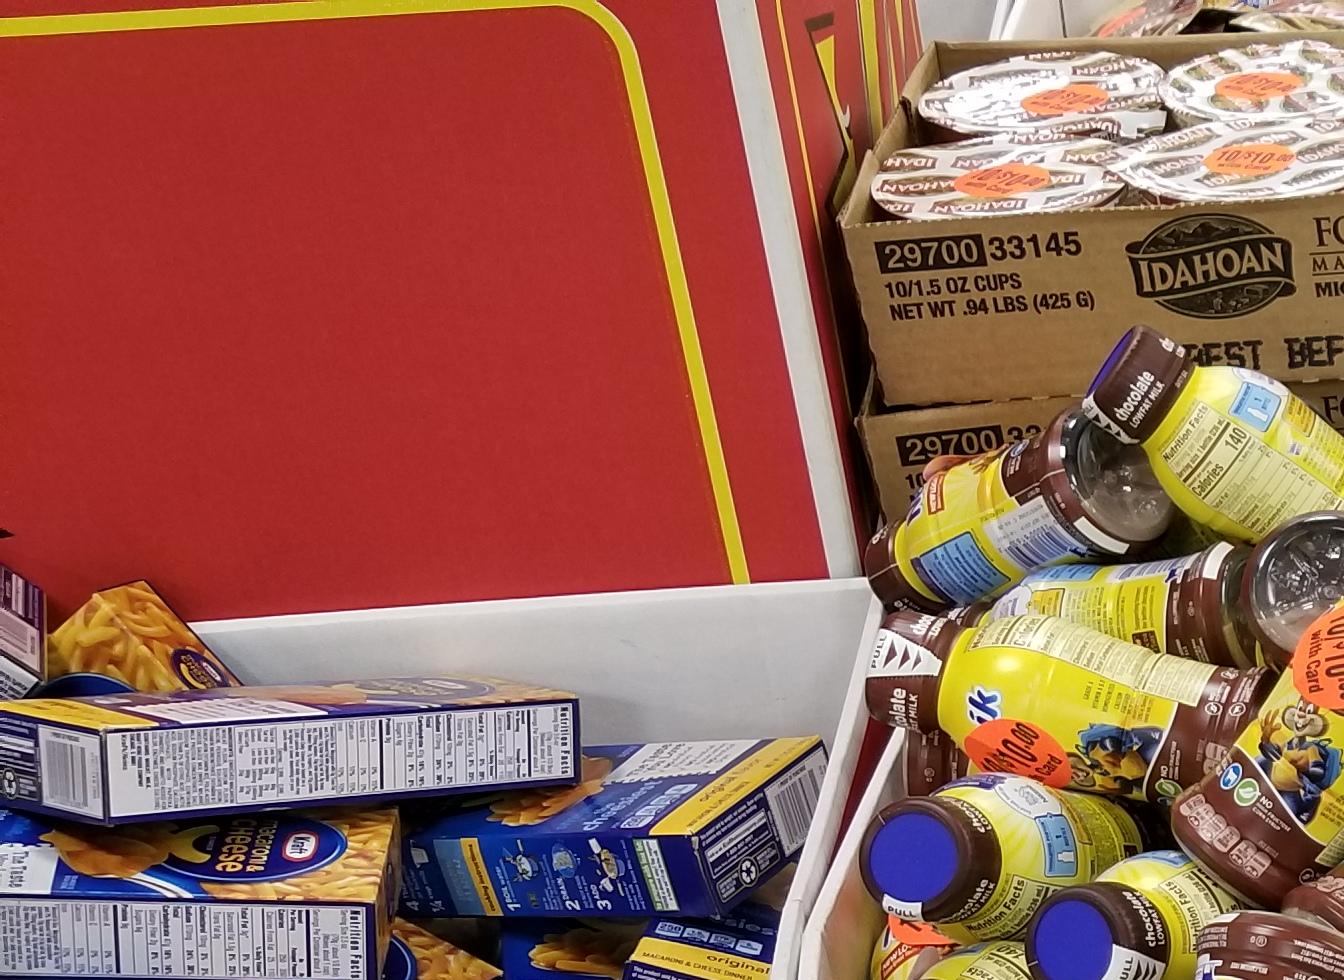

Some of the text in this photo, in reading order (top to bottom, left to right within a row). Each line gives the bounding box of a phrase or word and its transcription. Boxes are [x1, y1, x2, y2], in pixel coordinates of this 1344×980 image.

[884, 231, 1082, 269] 29700 33145
[1137, 242, 1286, 294] IDAHOAN
[885, 273, 1022, 298] 10/1.5 OZ CUPS
[890, 291, 1095, 321] NET WT .94 LBS (425 G)
[1113, 371, 1155, 421] chocolate
[905, 429, 997, 462] 29700
[1225, 427, 1247, 450] 140
[871, 635, 887, 668] PULL
[1306, 630, 1324, 694] with Card
[291, 835, 310, 860] Kraft
[966, 879, 1026, 932] Nutrition Facts
[1165, 880, 1186, 906] Facts
[888, 904, 917, 918] PULL
[350, 910, 364, 979] Nutrition Facts
[706, 953, 770, 976] original
